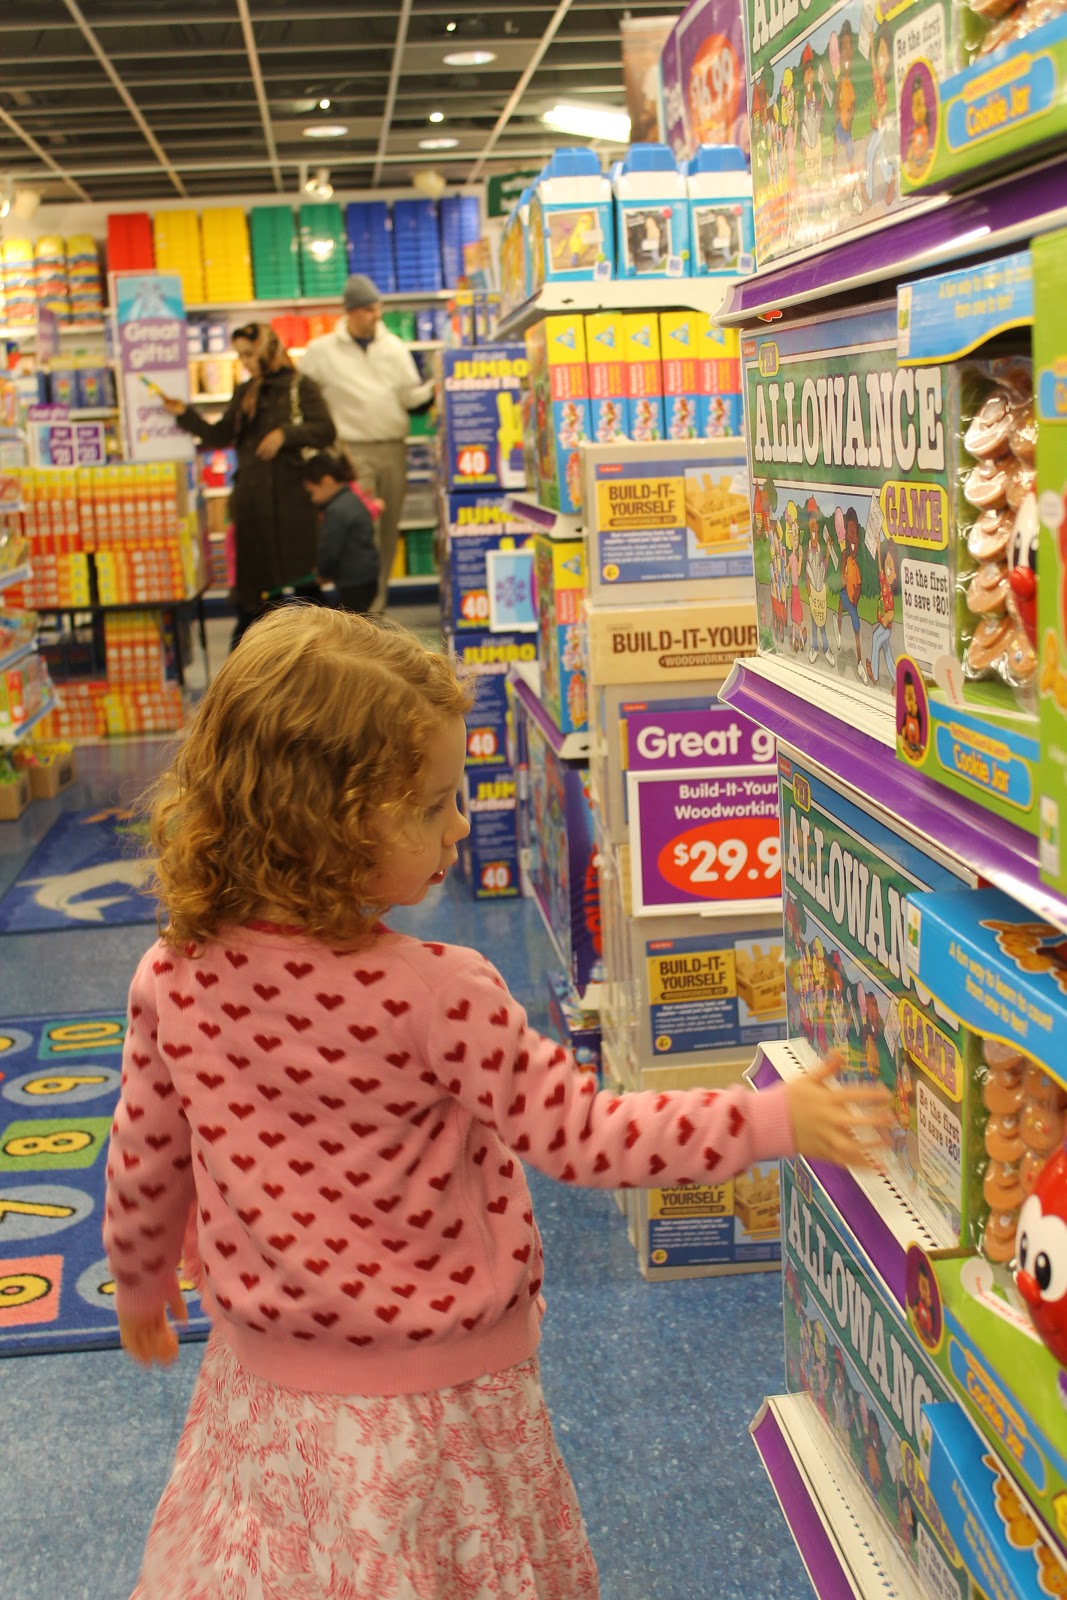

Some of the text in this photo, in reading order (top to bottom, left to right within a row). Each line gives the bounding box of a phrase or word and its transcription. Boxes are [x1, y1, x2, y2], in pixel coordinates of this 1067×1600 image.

[124, 322, 180, 342] Great
[453, 358, 530, 379] JUMBO
[754, 367, 946, 471] ALLOWANCE
[459, 450, 487, 476] 40
[609, 483, 675, 500] BUILD-IT-
[458, 506, 523, 526] JUM
[610, 500, 675, 516] YOURSELF
[885, 485, 943, 542] GAME
[904, 566, 948, 594] Be the first
[463, 596, 488, 619] 40
[904, 588, 949, 616] to save $20!
[613, 624, 758, 653] BUILD-IT-YOUR
[463, 643, 536, 665] JUMBO
[468, 733, 496, 757] 40
[636, 723, 742, 760] Great
[953, 743, 1010, 794] Cookie Jar
[477, 782, 516, 800] JUM
[679, 781, 778, 799] Build-It-Your
[673, 836, 781, 883] $29.9
[483, 867, 508, 888] 40
[788, 806, 958, 1031] ALLOWAN
[660, 956, 725, 975] BUILD-IT-
[661, 972, 726, 990] YOURSELF
[903, 1003, 957, 1096] GAME
[919, 1087, 960, 1143] Be the first
[919, 1107, 927, 1128] to
[928, 1120, 943, 1146] save
[3, 1130, 95, 1158] 8
[661, 1191, 725, 1206] YOURSELF
[788, 1186, 938, 1462] ALLOWANC
